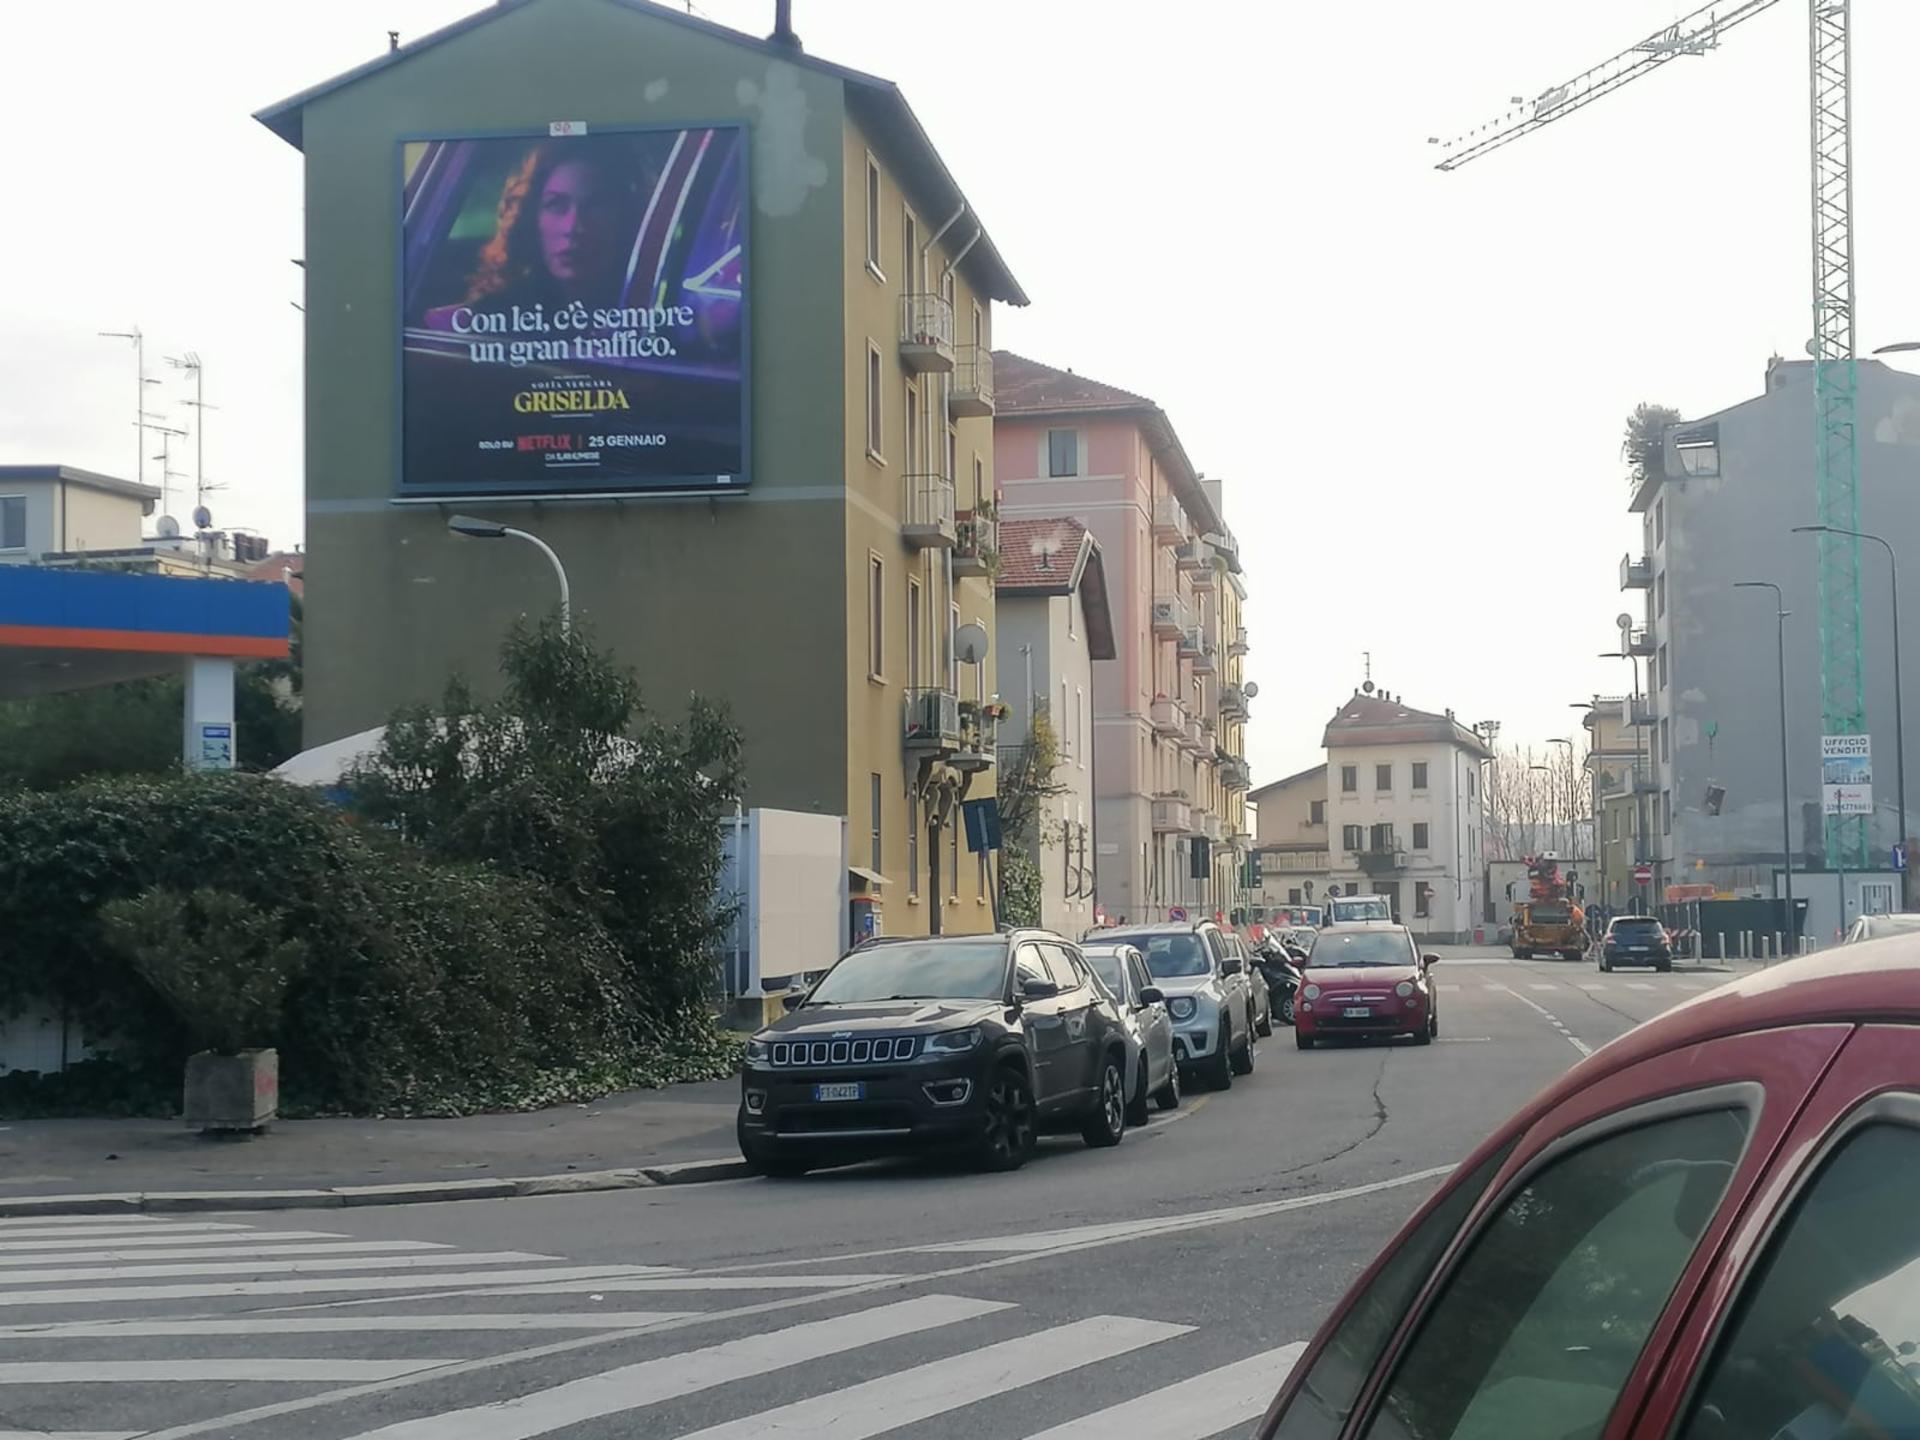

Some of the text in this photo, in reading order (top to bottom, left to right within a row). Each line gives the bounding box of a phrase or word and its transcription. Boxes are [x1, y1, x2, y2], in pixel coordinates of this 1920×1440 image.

[451, 307, 507, 334] Con
[511, 303, 550, 334] lei,
[592, 305, 694, 334] sempre
[470, 329, 677, 368] un gran traffico.
[513, 389, 630, 412] GRISELDA
[517, 434, 572, 452] NETFLIX
[588, 435, 605, 448] 25
[606, 434, 667, 447] GENNAIO
[1824, 746, 1868, 754] VENDITE
[1825, 738, 1867, 746] UFFICIO
